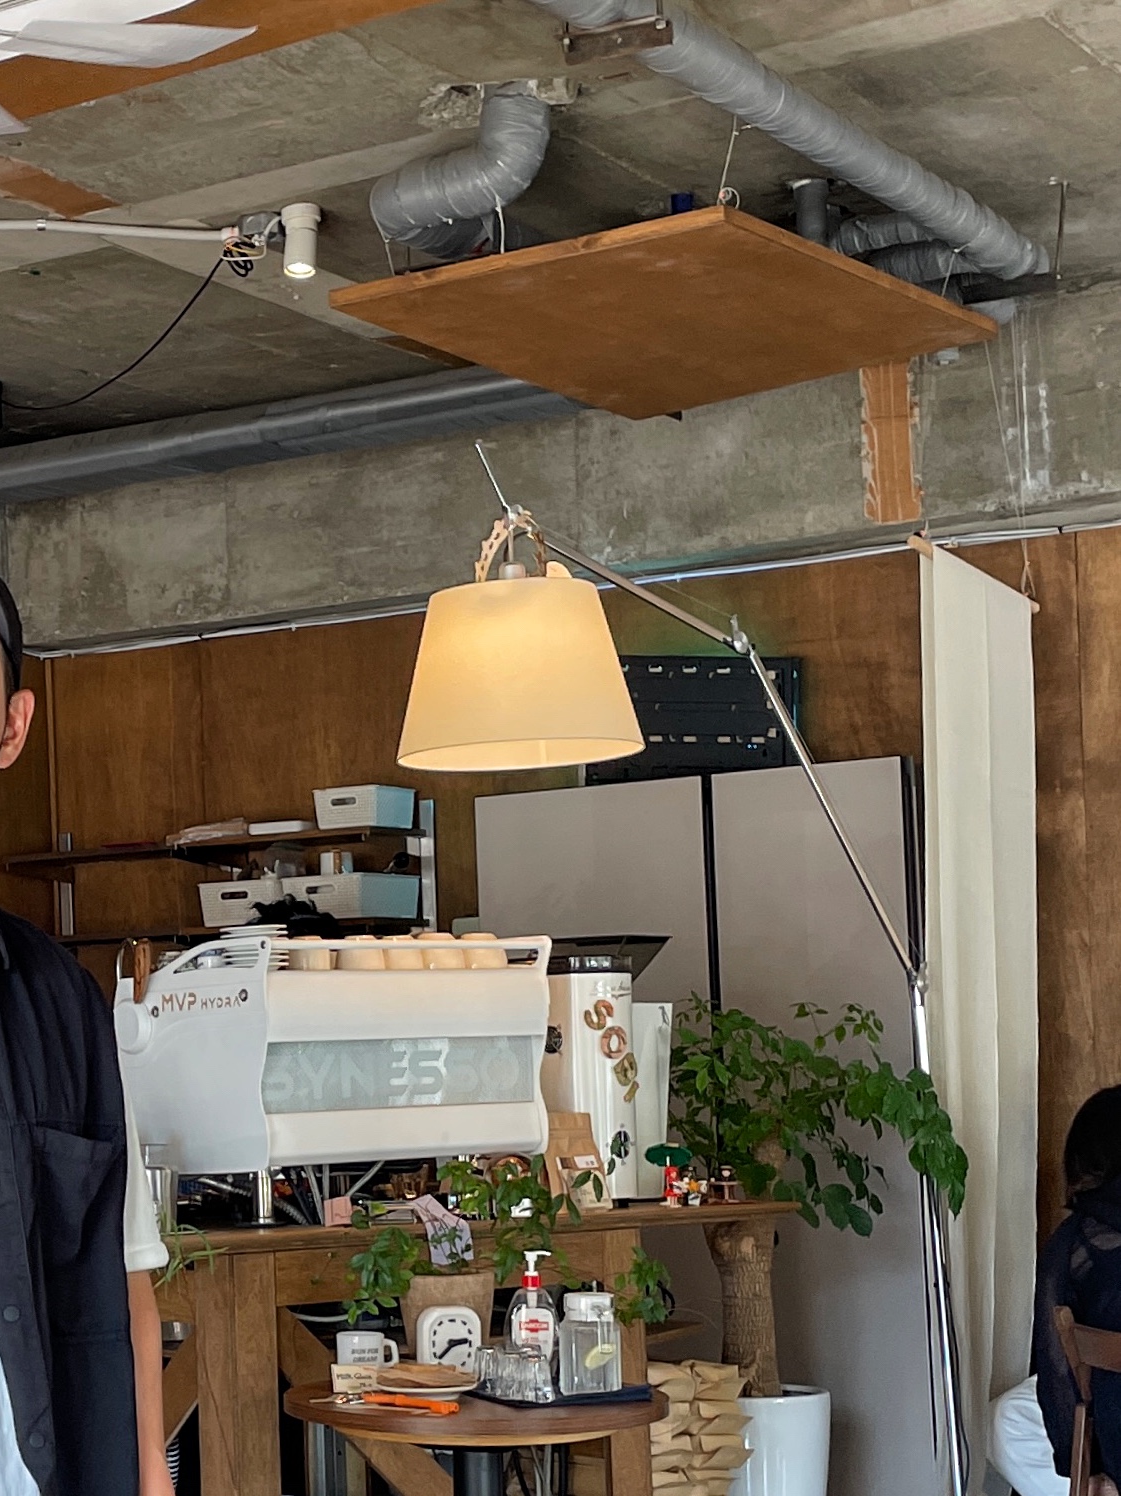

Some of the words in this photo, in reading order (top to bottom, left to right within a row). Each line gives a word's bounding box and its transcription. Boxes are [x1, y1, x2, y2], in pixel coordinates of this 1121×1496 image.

[161, 992, 197, 1012] MVP
[200, 995, 242, 1010] HYDRA
[263, 1046, 520, 1101] SYNESSO
